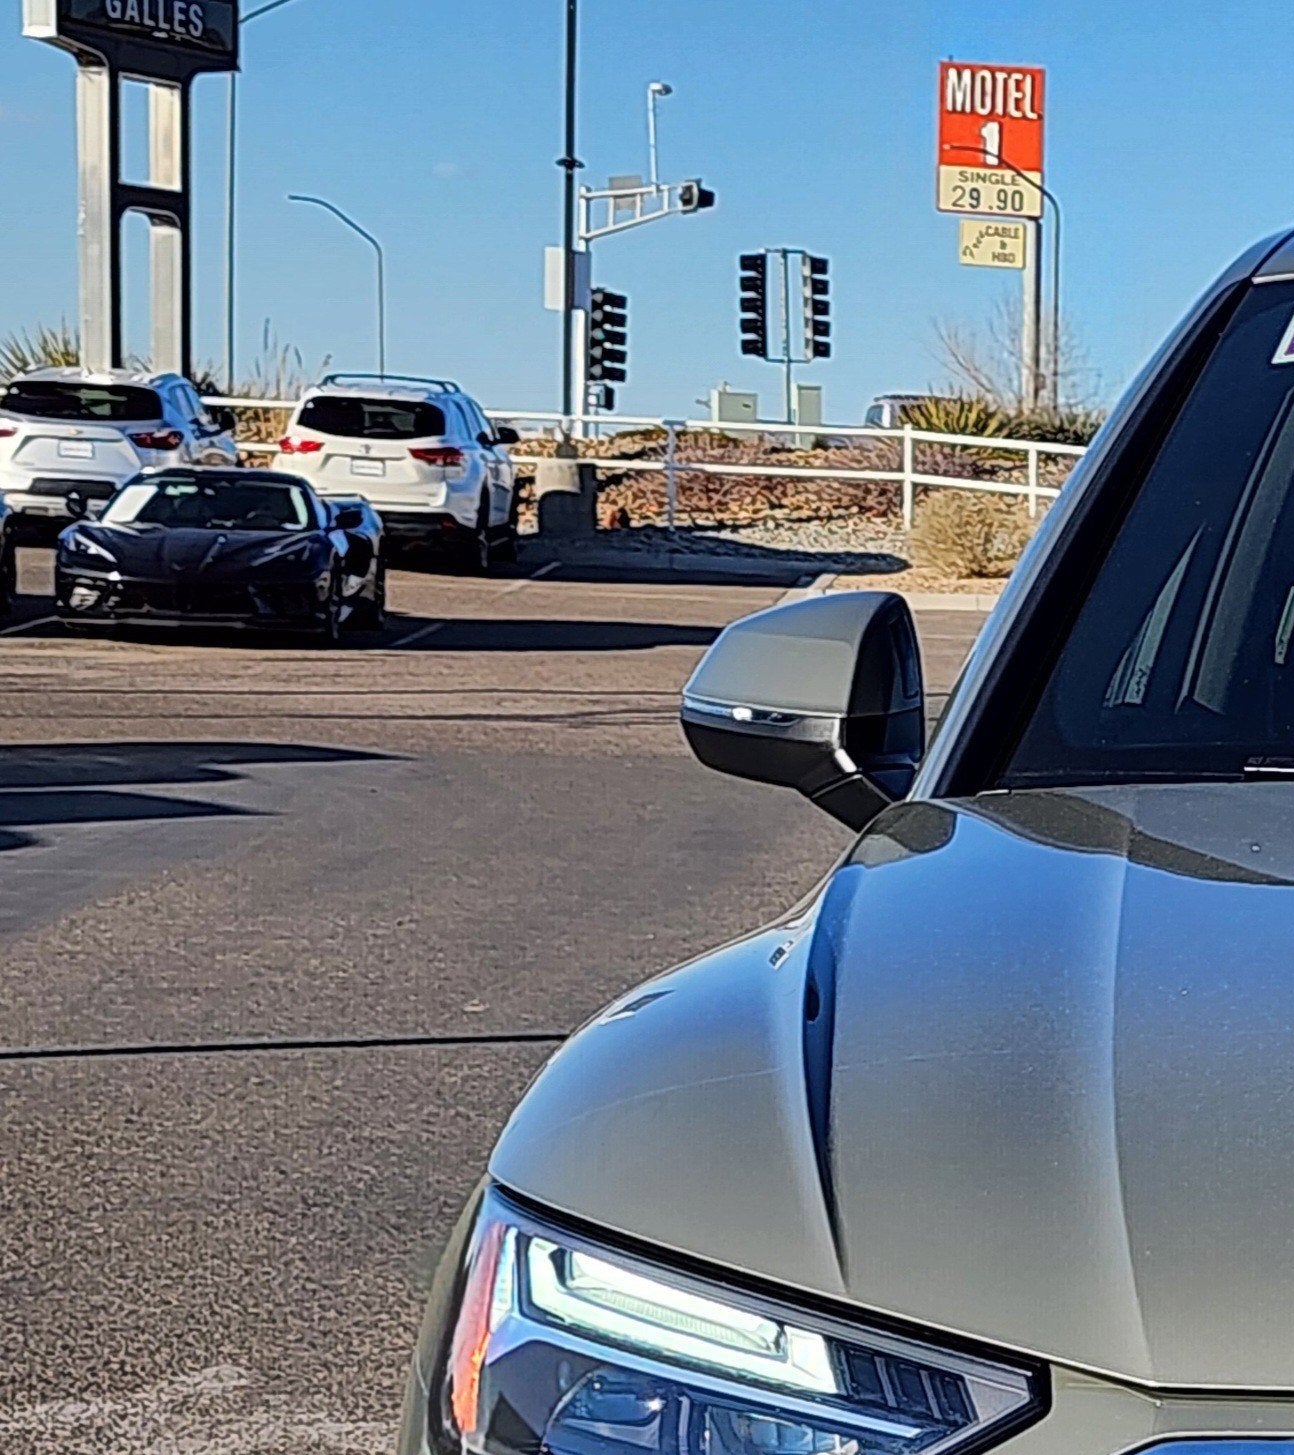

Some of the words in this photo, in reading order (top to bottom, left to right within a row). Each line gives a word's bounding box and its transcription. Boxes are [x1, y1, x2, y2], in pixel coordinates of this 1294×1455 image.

[105, 0, 203, 37] GALLES
[946, 67, 1038, 120] MOTEL
[981, 121, 1000, 166] 1
[958, 170, 1021, 186] SINGLE
[951, 185, 1024, 212] 29.90
[984, 225, 1020, 239] CABLE
